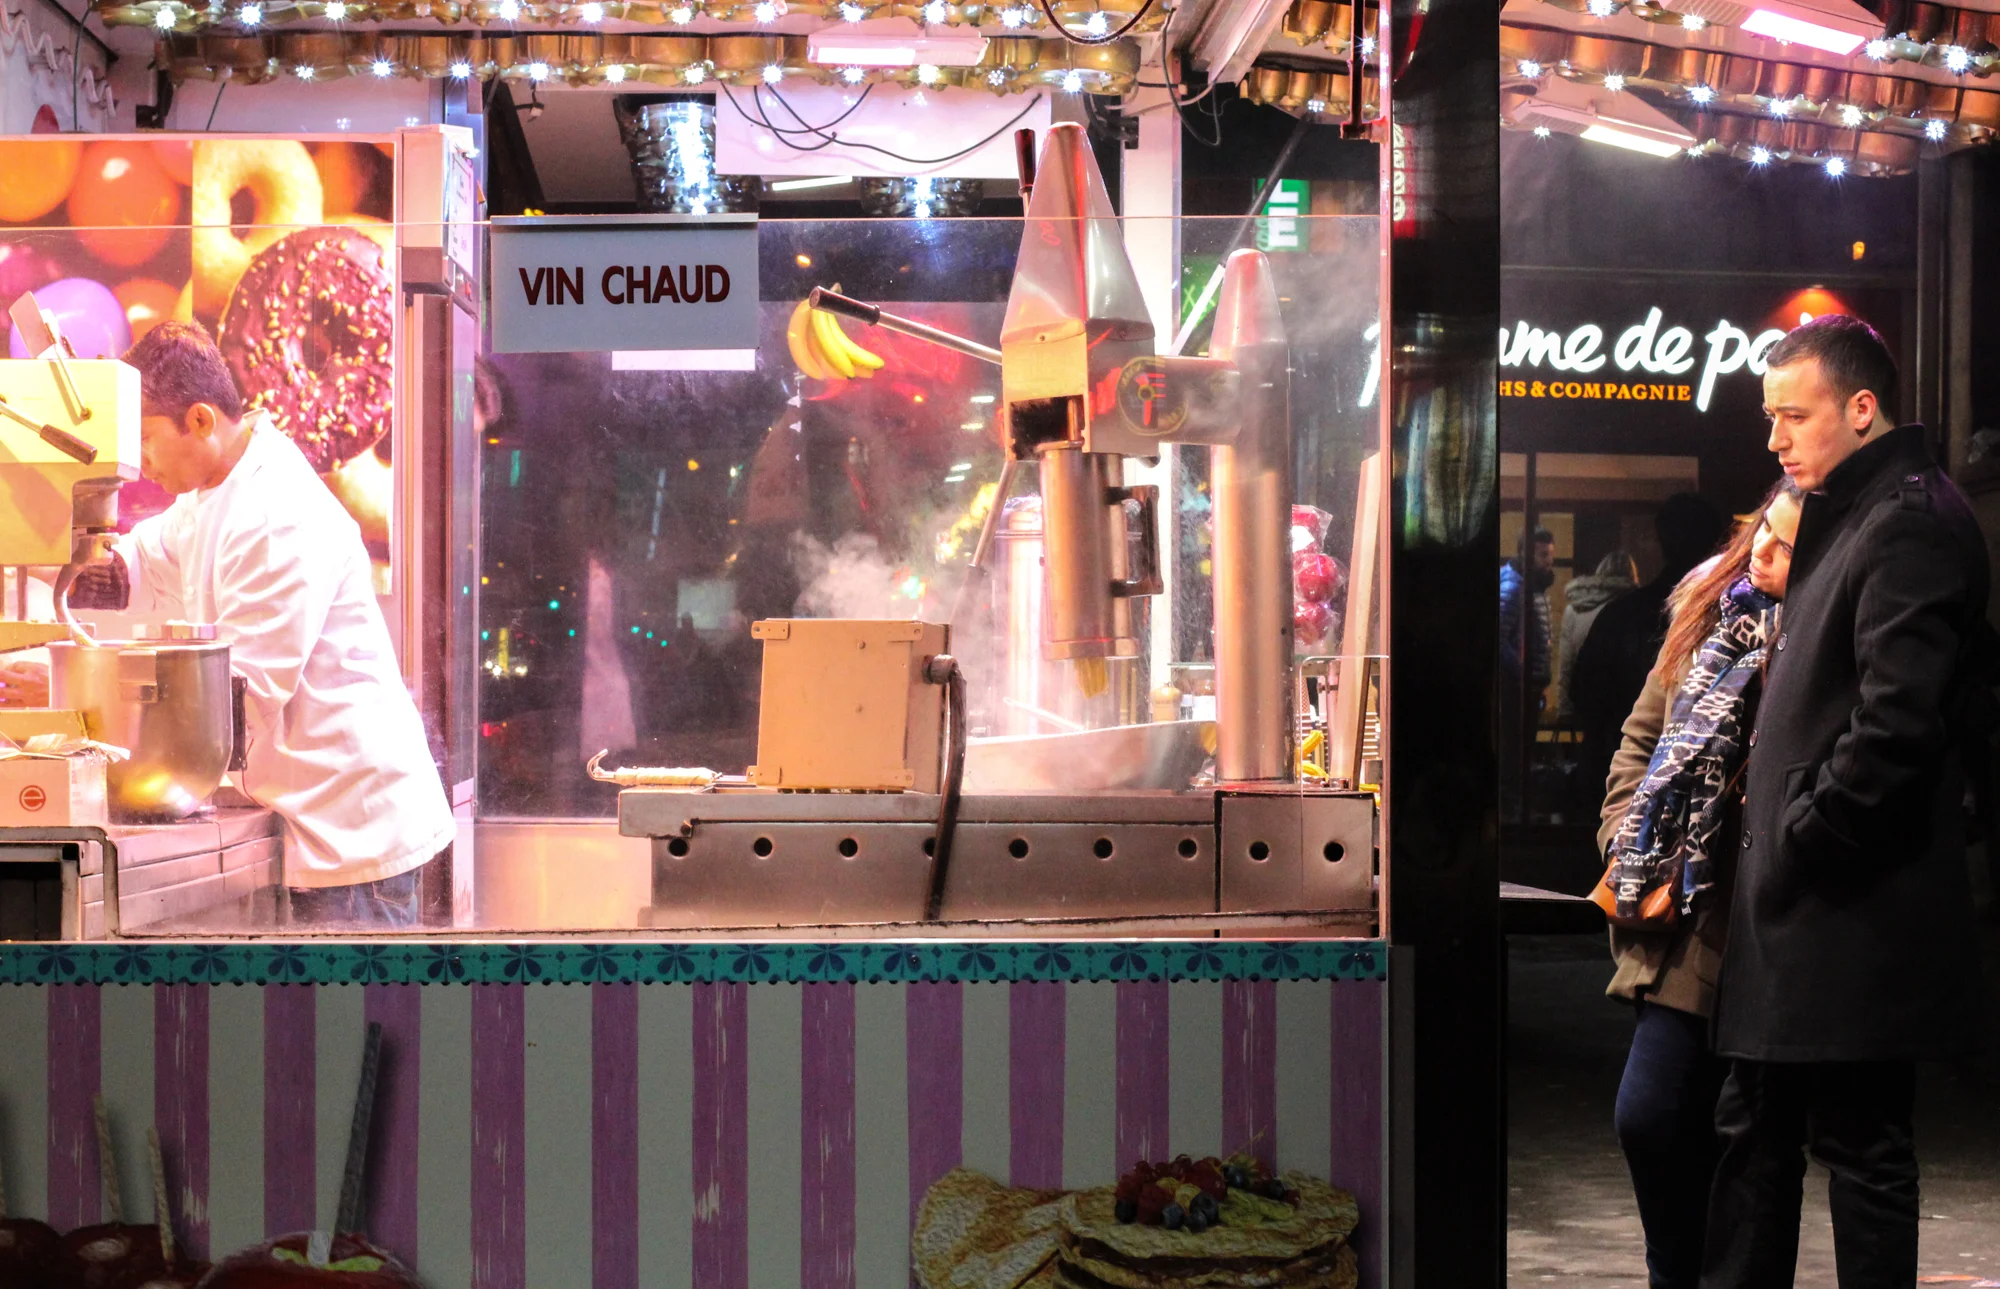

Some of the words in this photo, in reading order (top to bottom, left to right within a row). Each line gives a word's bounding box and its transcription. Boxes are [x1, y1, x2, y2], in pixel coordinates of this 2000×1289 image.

[519, 267, 584, 305] VIN
[601, 265, 731, 305] CHAUD
[1614, 306, 1694, 374] de
[1549, 382, 1691, 400] COMPAGNIE
